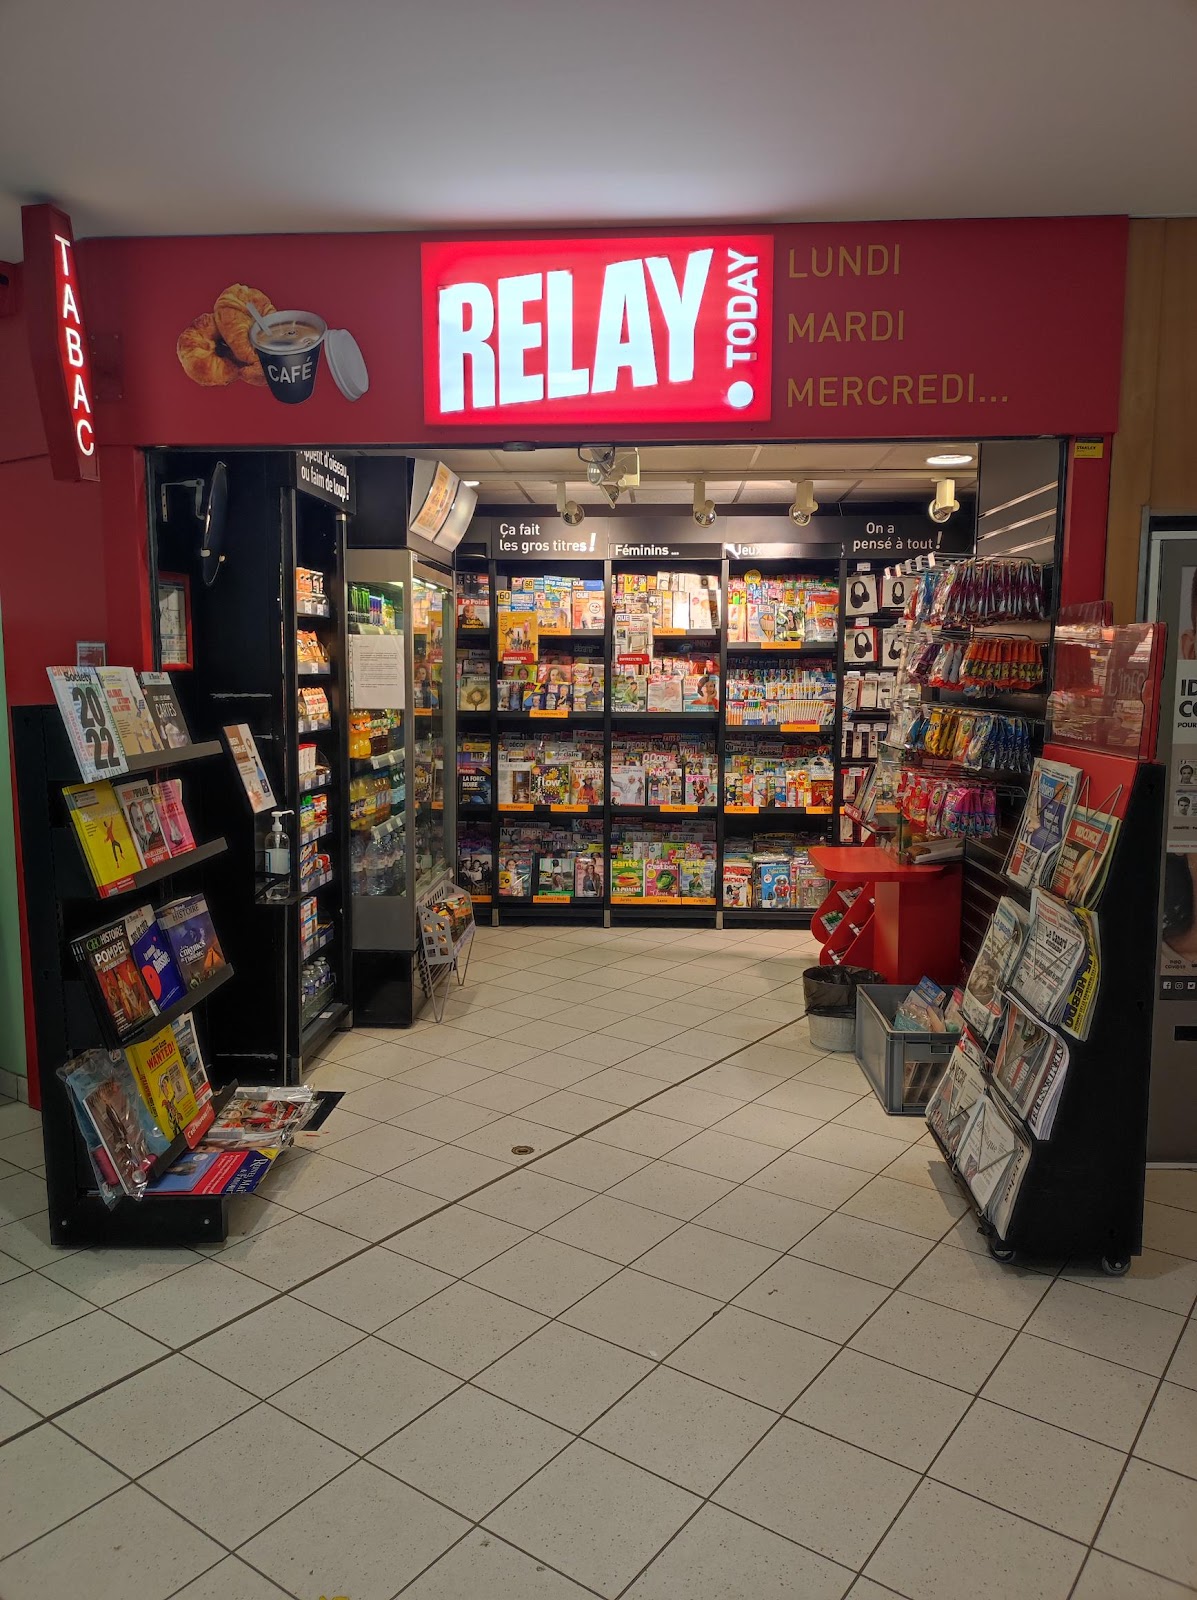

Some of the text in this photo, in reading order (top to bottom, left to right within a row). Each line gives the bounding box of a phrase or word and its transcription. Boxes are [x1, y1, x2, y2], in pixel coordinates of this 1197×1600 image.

[788, 243, 900, 278] LUNDI
[726, 247, 758, 368] TODAY
[438, 247, 714, 413] RELAY
[787, 309, 905, 343] MARDI
[54, 233, 95, 456] TABAC
[267, 356, 313, 384] CAFÉ
[786, 372, 1009, 407] MERCREDI...
[301, 466, 310, 482] ou
[310, 466, 324, 489] faim
[326, 474, 333, 492] de
[500, 523, 541, 536] Ça fait
[866, 522, 895, 534] On a
[499, 540, 518, 551] les
[521, 542, 550, 553] gros
[615, 544, 669, 556] Féminins
[853, 537, 892, 552] pensé
[896, 537, 904, 549] à
[500, 592, 510, 600] 60
[64, 671, 92, 685] Society
[72, 686, 106, 728] 20
[156, 702, 176, 718] CARTES
[86, 728, 120, 770] 22
[537, 776, 561, 786] flow
[612, 860, 638, 868] santé
[172, 904, 200, 922] HISTOIRE
[100, 925, 124, 944] HISTOIRE
[1064, 980, 1088, 1028] HEBDO
[147, 1041, 176, 1070] WANTED!
